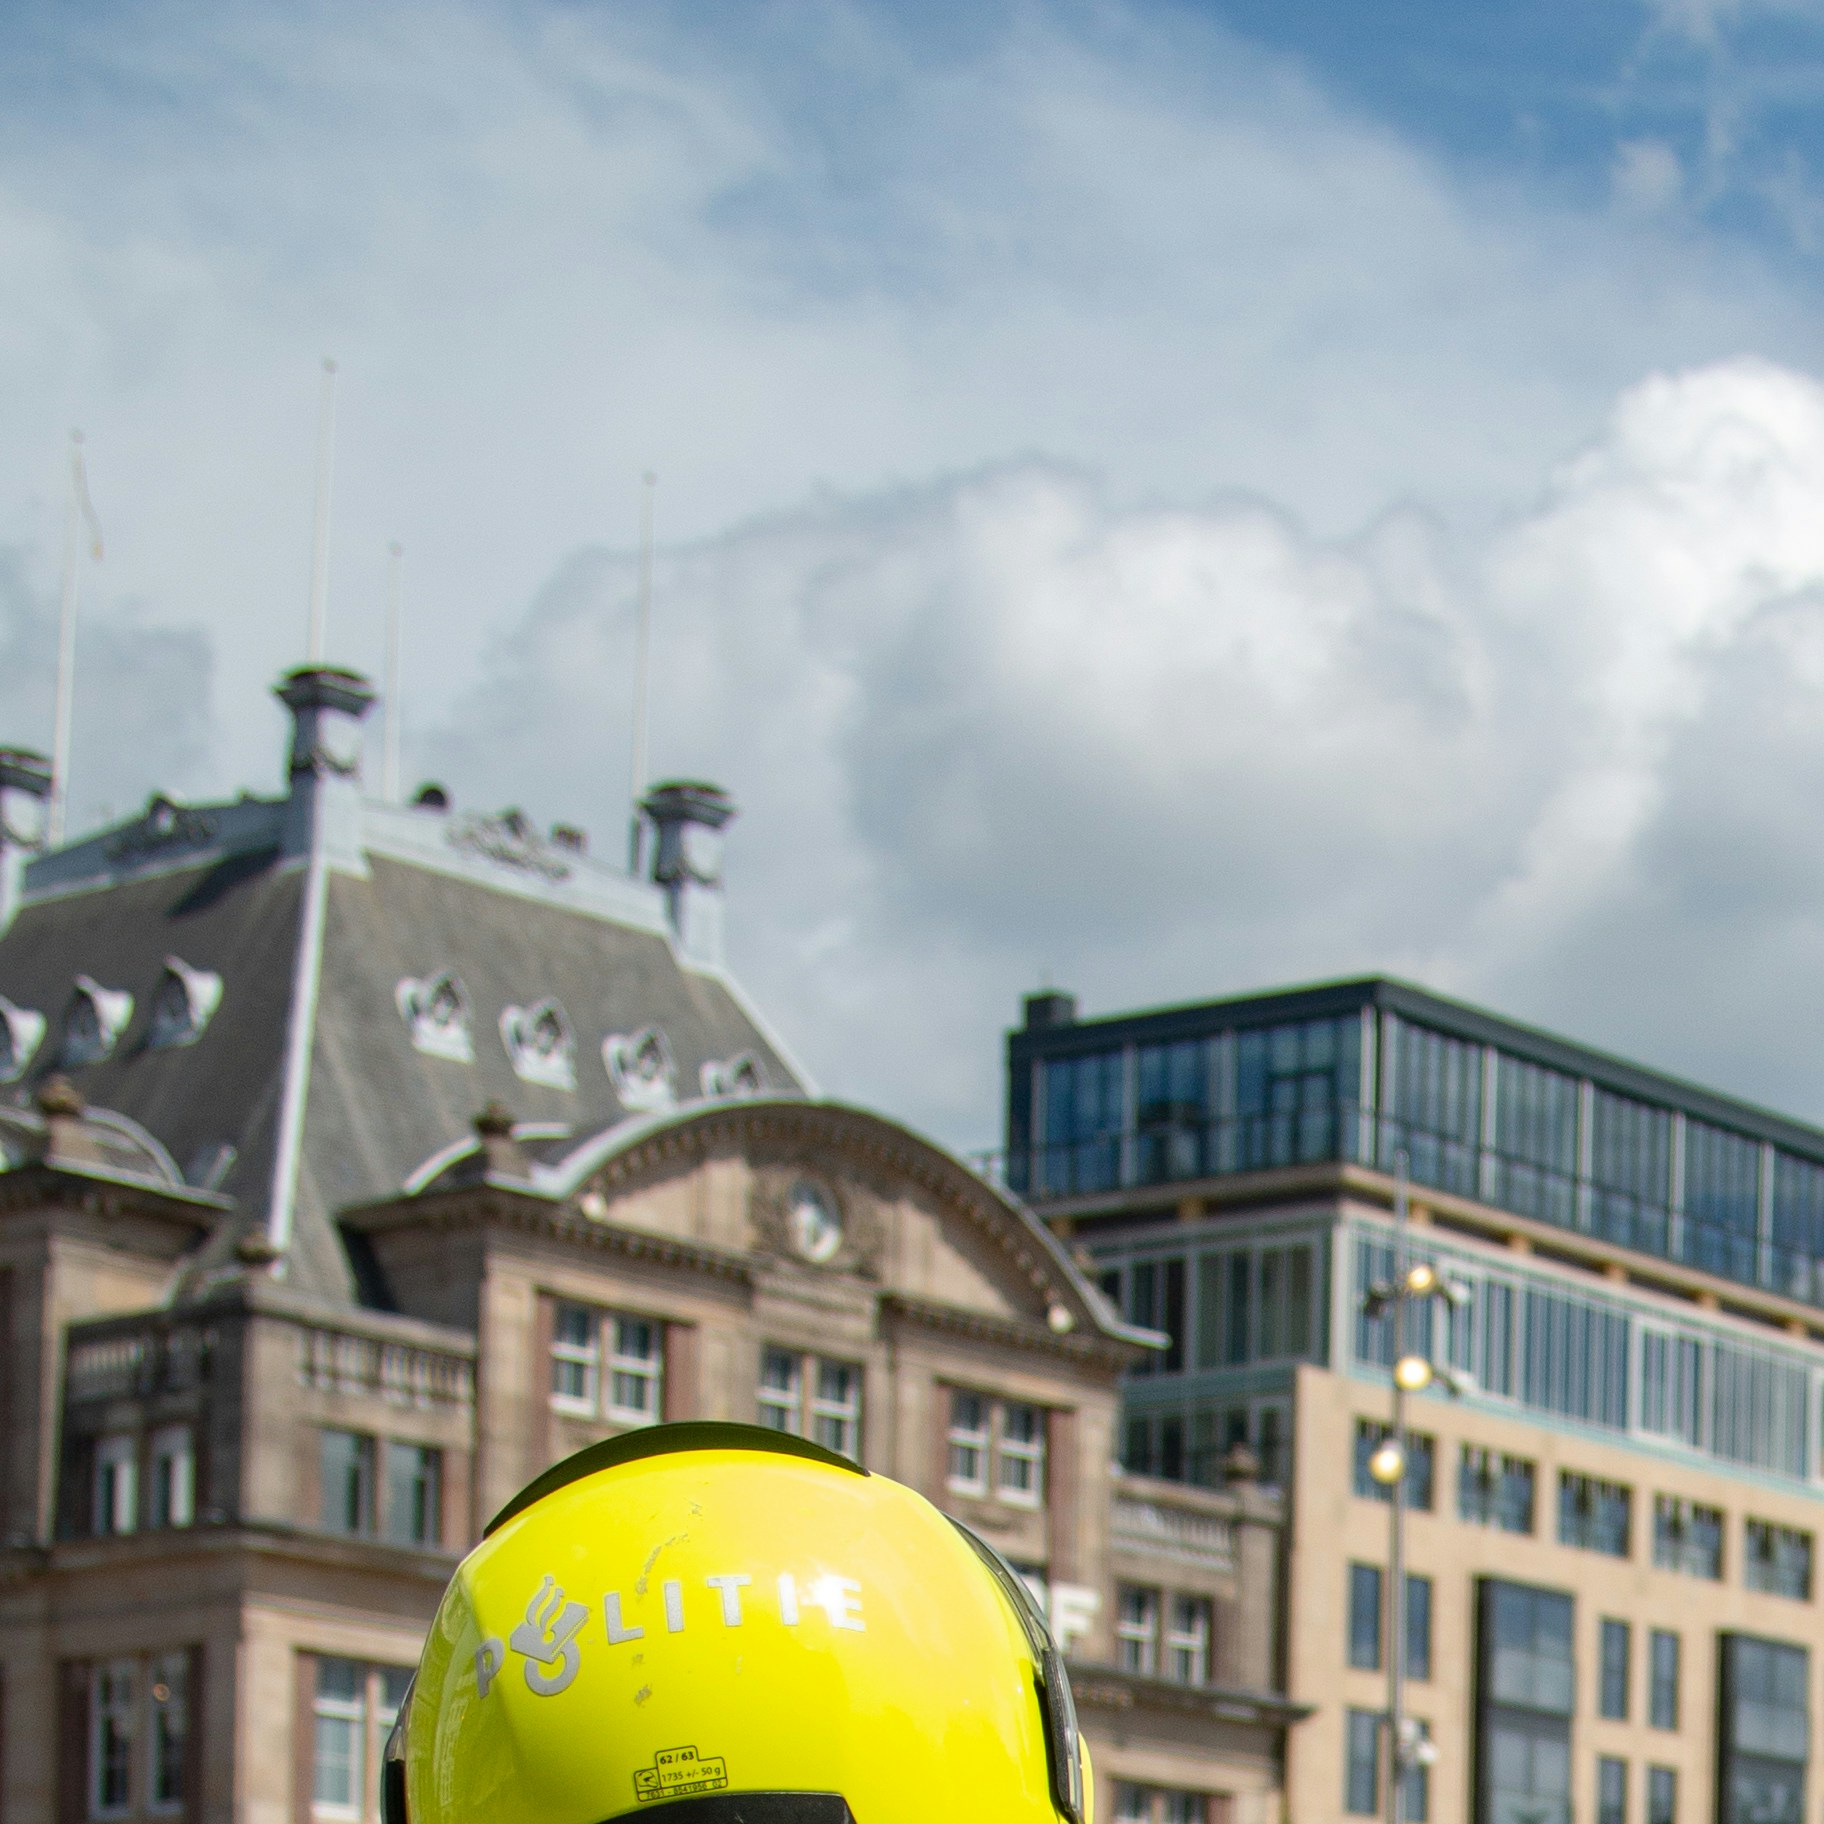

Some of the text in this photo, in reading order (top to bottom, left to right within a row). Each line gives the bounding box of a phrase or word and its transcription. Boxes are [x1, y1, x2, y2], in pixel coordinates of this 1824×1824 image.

[474, 1574, 866, 1698] POLITIE
[660, 1754, 673, 1765] 62
[681, 1751, 695, 1761] 63
[661, 1771, 684, 1783] 1735
[700, 1766, 713, 1777] 50
[714, 1766, 721, 1777] g
